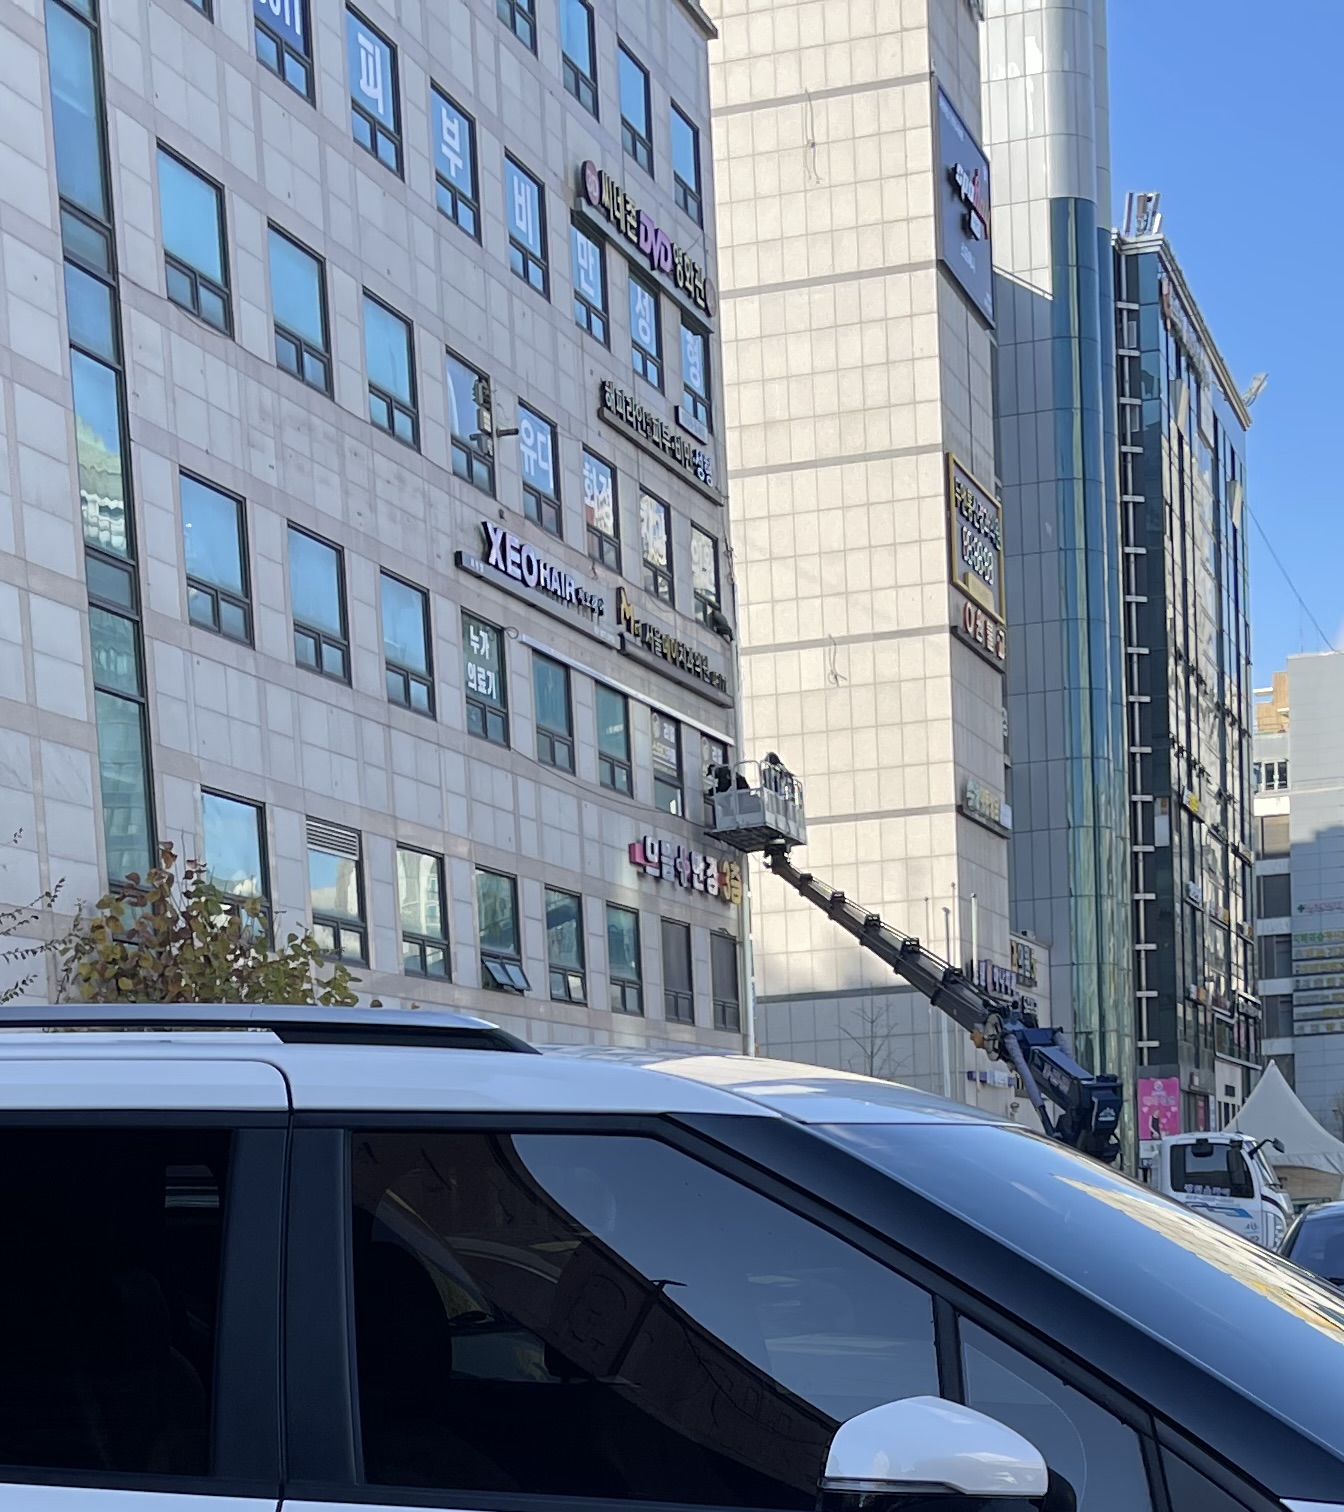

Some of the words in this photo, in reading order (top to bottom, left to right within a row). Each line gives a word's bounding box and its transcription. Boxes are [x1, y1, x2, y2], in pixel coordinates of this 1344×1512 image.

[357, 32, 384, 115] 피
[441, 106, 463, 177] 부
[513, 175, 534, 245] 비
[576, 232, 595, 297] 만
[520, 418, 554, 489] 유디
[486, 521, 539, 587] XEO
[539, 560, 576, 603] HAIR
[469, 625, 490, 660] 누가
[467, 662, 497, 699] 의료기
